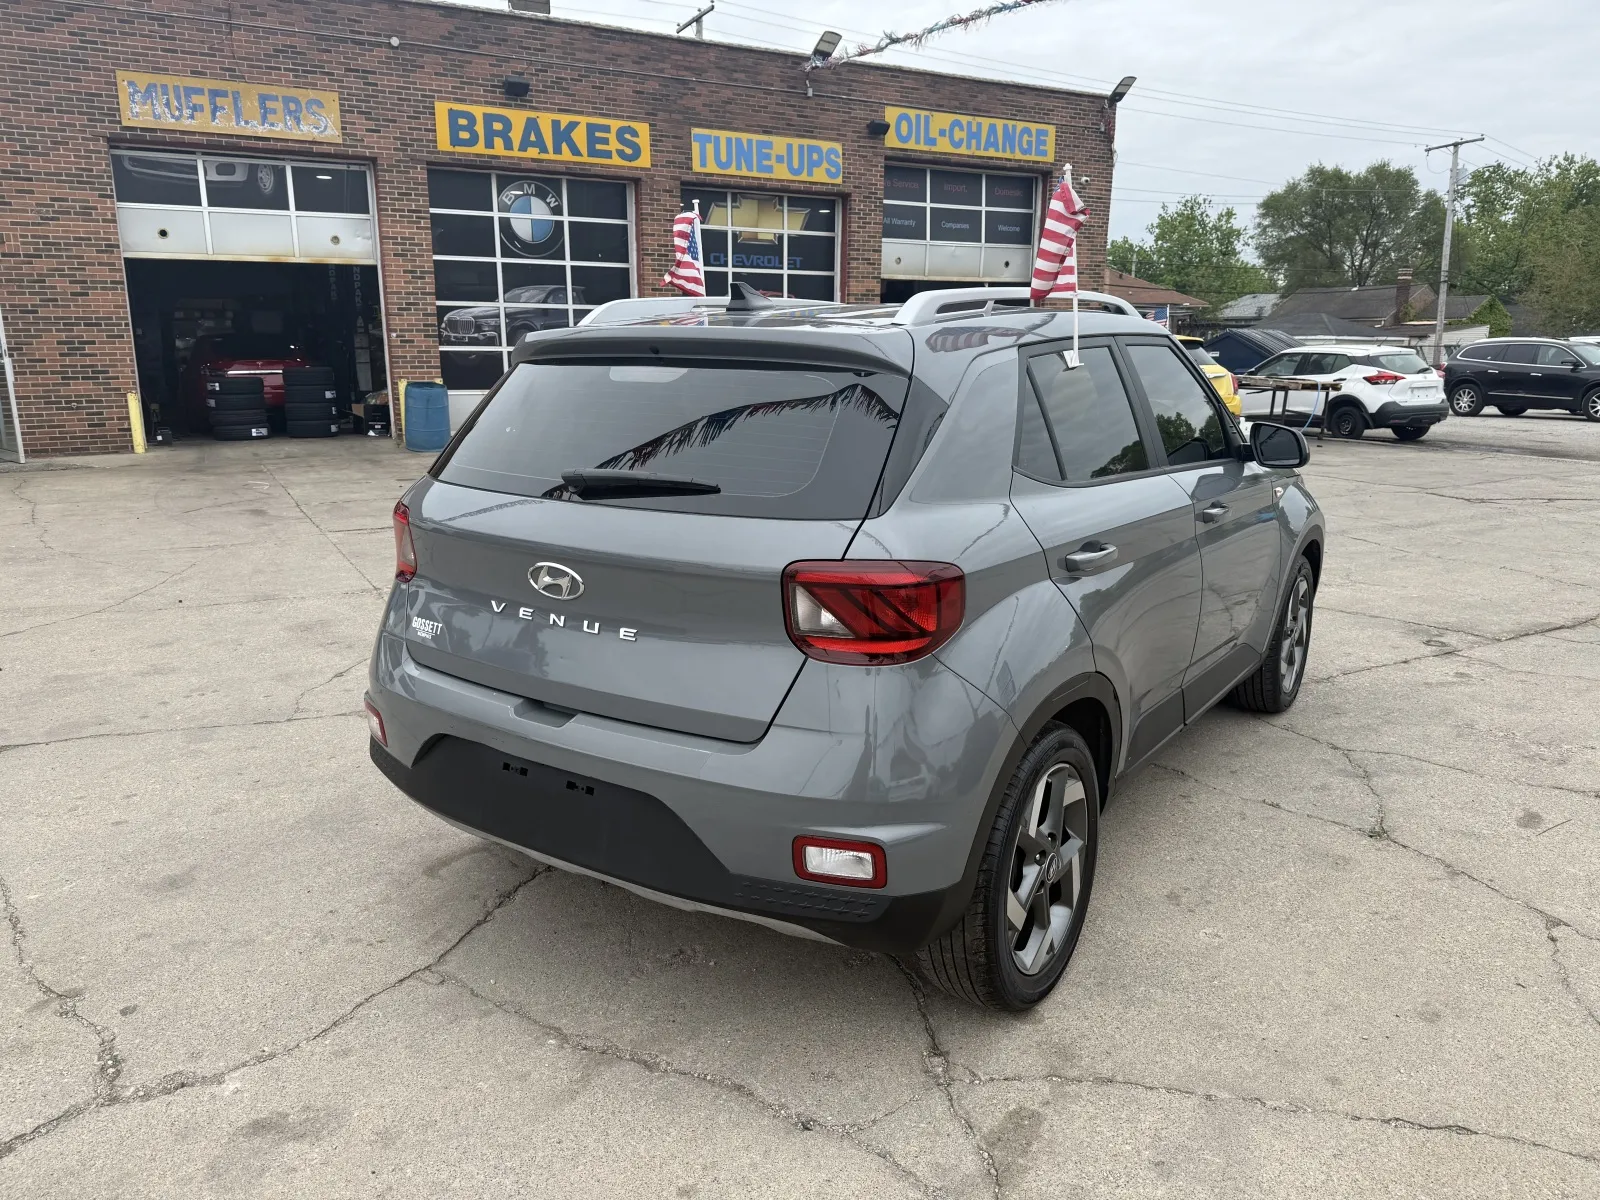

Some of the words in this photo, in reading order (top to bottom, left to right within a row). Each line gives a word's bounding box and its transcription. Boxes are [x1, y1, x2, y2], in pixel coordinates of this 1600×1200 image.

[126, 79, 332, 136] MUFFLERS
[447, 108, 642, 162] BRAKES
[894, 112, 1049, 158] OIL-CHANGE
[692, 133, 842, 180] TUNE-UPS
[501, 183, 561, 208] BMW
[891, 218, 916, 227] Warranty
[941, 220, 970, 230] Companies
[997, 224, 1021, 232] Welcome
[709, 252, 804, 269] CHEVROLET
[352, 266, 362, 304] NDPAK
[411, 616, 443, 635] GOSSETT
[490, 599, 638, 642] VENUE
